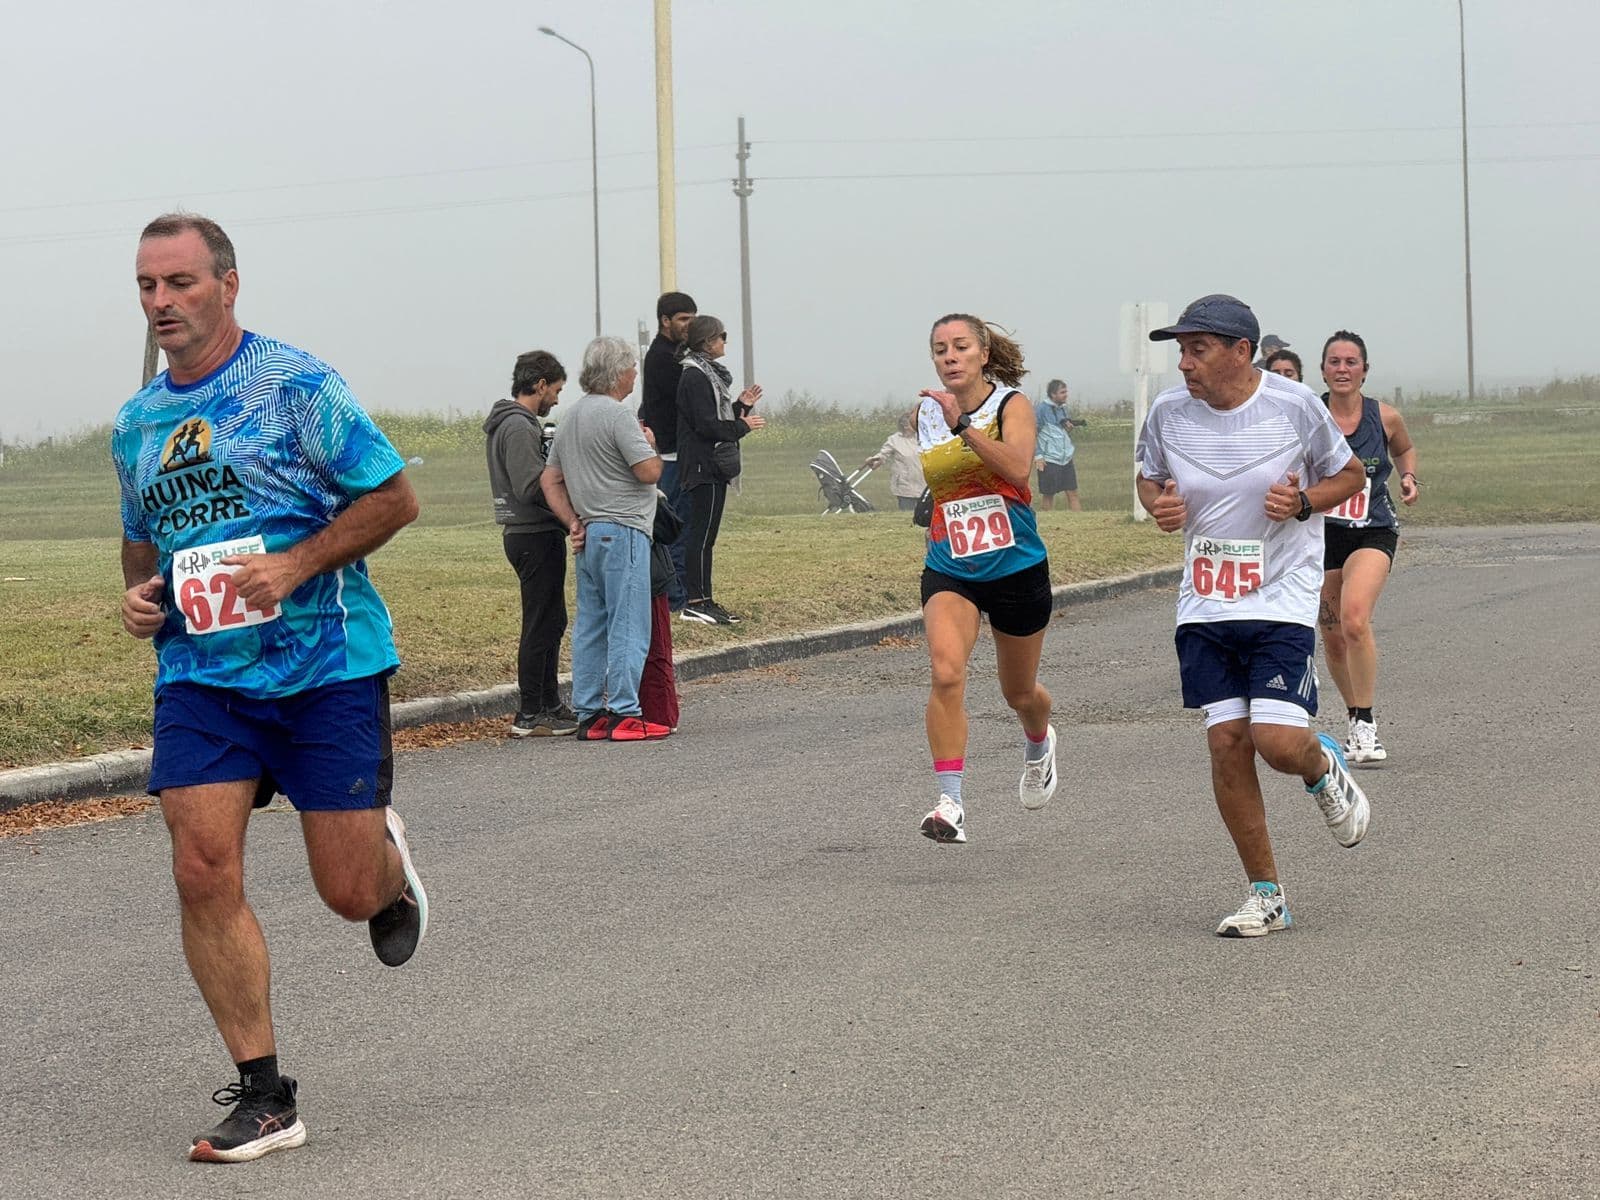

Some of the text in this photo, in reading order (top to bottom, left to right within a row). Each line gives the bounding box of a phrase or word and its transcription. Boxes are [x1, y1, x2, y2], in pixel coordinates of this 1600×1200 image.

[141, 465, 244, 513] HUINCA
[968, 498, 1001, 510] RUFF
[157, 495, 249, 536] CORRE
[949, 511, 1012, 556] 629
[1222, 544, 1260, 553] RUFF
[1193, 556, 1262, 599] 645
